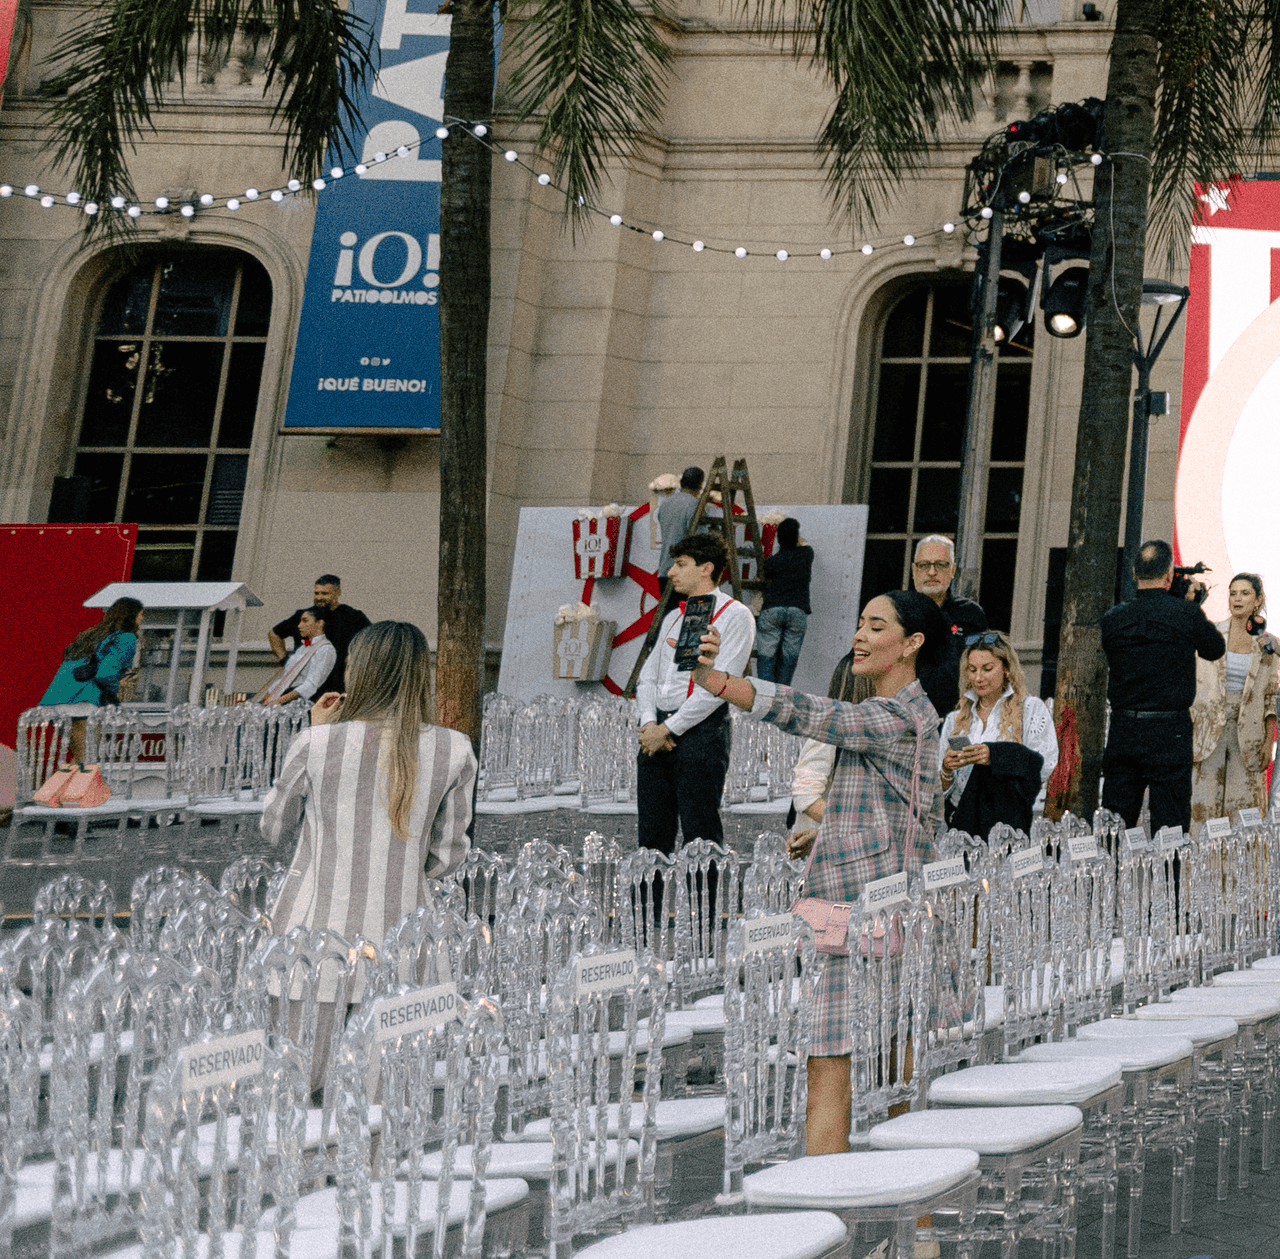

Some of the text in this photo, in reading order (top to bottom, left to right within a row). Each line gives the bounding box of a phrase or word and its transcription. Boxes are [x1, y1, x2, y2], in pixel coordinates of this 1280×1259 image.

[317, 376, 427, 392] ¡QUÉ BUENO!
[927, 863, 965, 883] RESERVADO
[1014, 852, 1042, 872] RESERVADO
[869, 881, 907, 904] RESERVADO
[749, 922, 791, 943] RESERVADO
[581, 959, 634, 985] RESERVADO
[380, 993, 455, 1029] RESERVADO
[188, 1042, 262, 1078] RESERVADO
